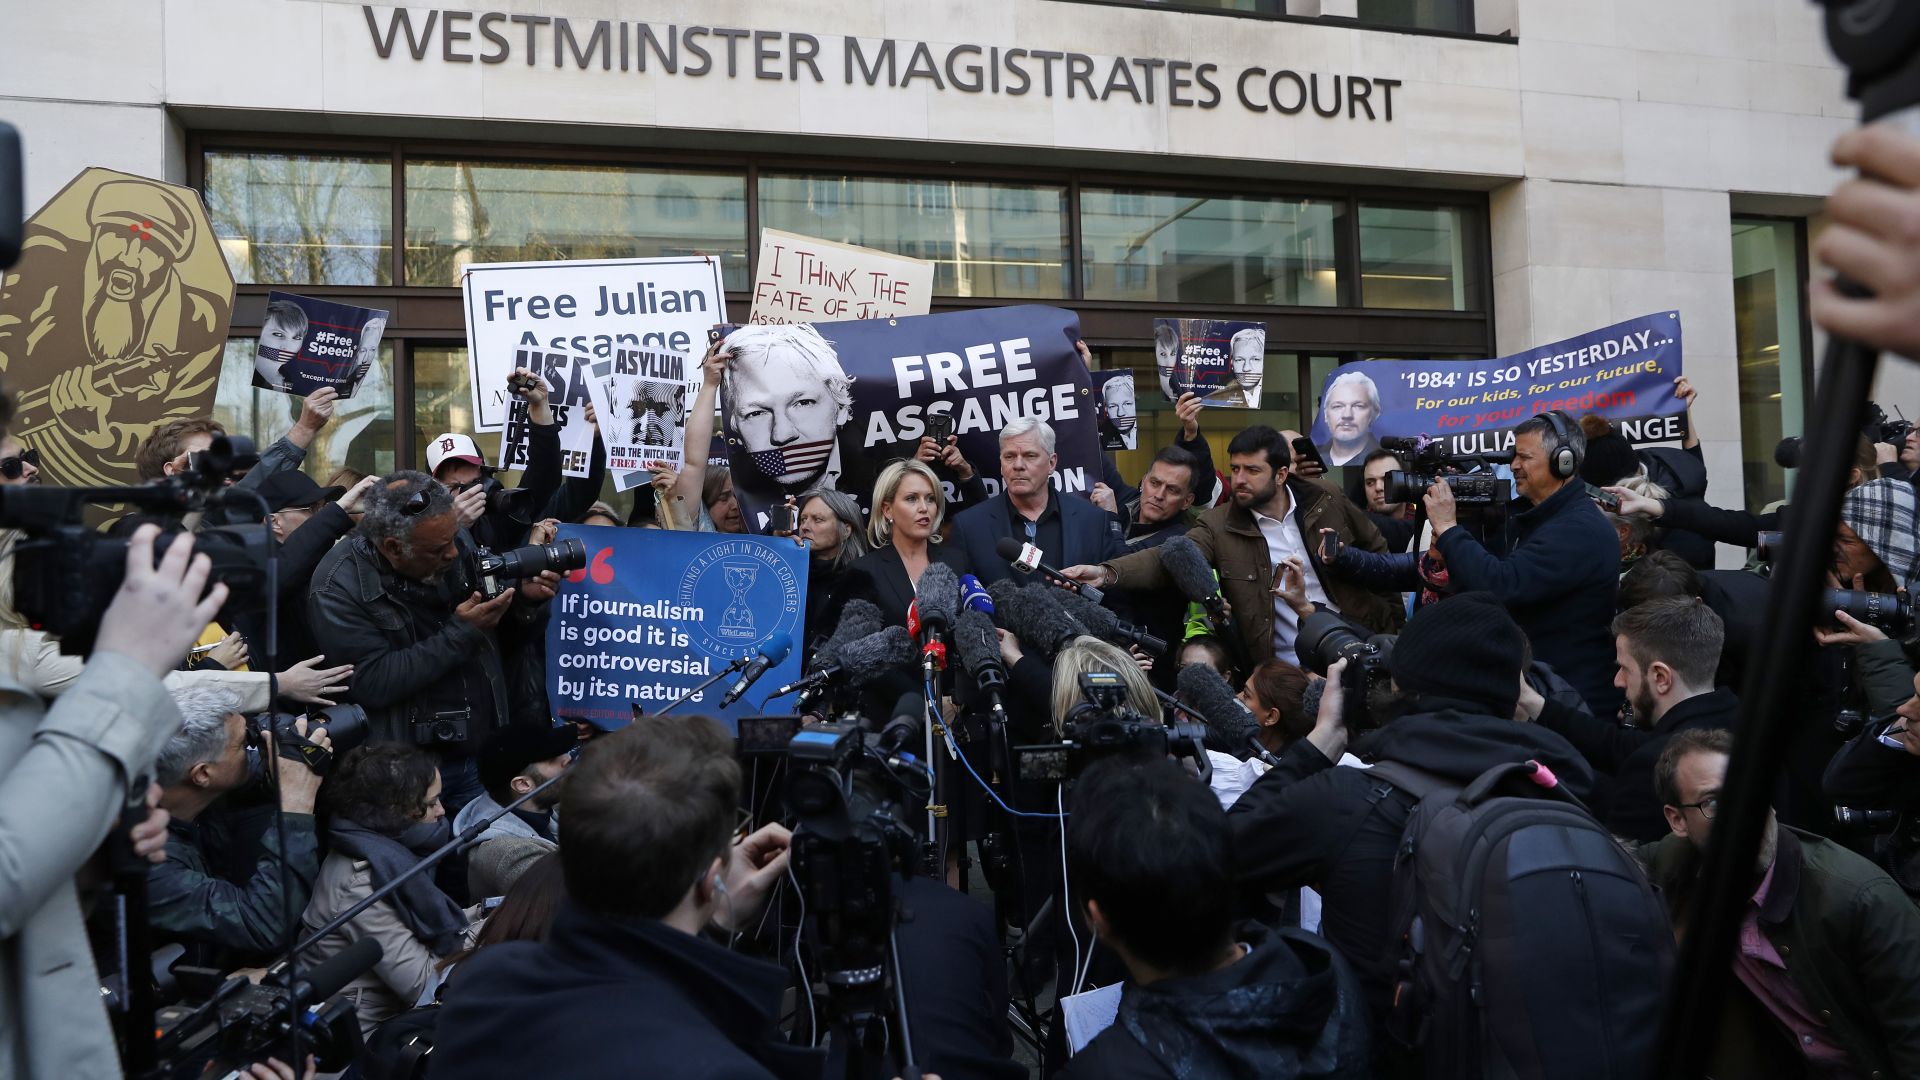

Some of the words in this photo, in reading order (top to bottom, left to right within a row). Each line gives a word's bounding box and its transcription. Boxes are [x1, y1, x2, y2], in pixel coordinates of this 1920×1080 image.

[362, 5, 824, 82] WESTMINSTER
[844, 36, 1221, 108] MAGISTRATES
[1237, 67, 1401, 121] COURT
[771, 245, 785, 278] I
[868, 272, 910, 305] THE
[485, 289, 577, 322] Free
[594, 281, 707, 316] Julian
[755, 282, 814, 313] FATE
[823, 298, 849, 318] OF
[315, 331, 353, 347] #Free
[1185, 345, 1220, 356] #Free
[514, 349, 592, 407] USA
[615, 349, 684, 381] ASYLUM
[892, 337, 1036, 399] FREE
[1400, 371, 1462, 390] '1984'
[1468, 371, 1486, 388] IS
[1491, 366, 1521, 385] SO
[1415, 396, 1444, 411] For
[1447, 397, 1478, 408] our
[1482, 387, 1522, 405] kids,
[1527, 381, 1554, 397] for
[1560, 377, 1588, 390] our
[1593, 359, 1663, 384] future,
[1437, 412, 1470, 429] for
[1472, 405, 1527, 429] your
[1531, 388, 1636, 415] freedom
[611, 446, 625, 457] END
[628, 447, 642, 458] THE
[643, 448, 665, 459] WITCH
[666, 450, 680, 461] HUNT
[1452, 430, 1516, 455] JULIA
[610, 458, 637, 468] FREE
[680, 565, 701, 607] SHINING
[699, 557, 708, 567] A
[708, 543, 736, 561] LIGHT
[741, 543, 752, 554] IN
[754, 546, 780, 567] DARK
[777, 566, 798, 613] CORNERS
[561, 594, 578, 613] If
[579, 596, 704, 621] journalism
[560, 620, 578, 641] is
[583, 625, 642, 646] good
[647, 625, 666, 646] it
[670, 627, 689, 647] is
[702, 638, 734, 656] SINCE
[558, 654, 710, 676] controversial
[557, 676, 584, 700] by
[589, 676, 619, 697] its
[625, 681, 704, 703] nature
